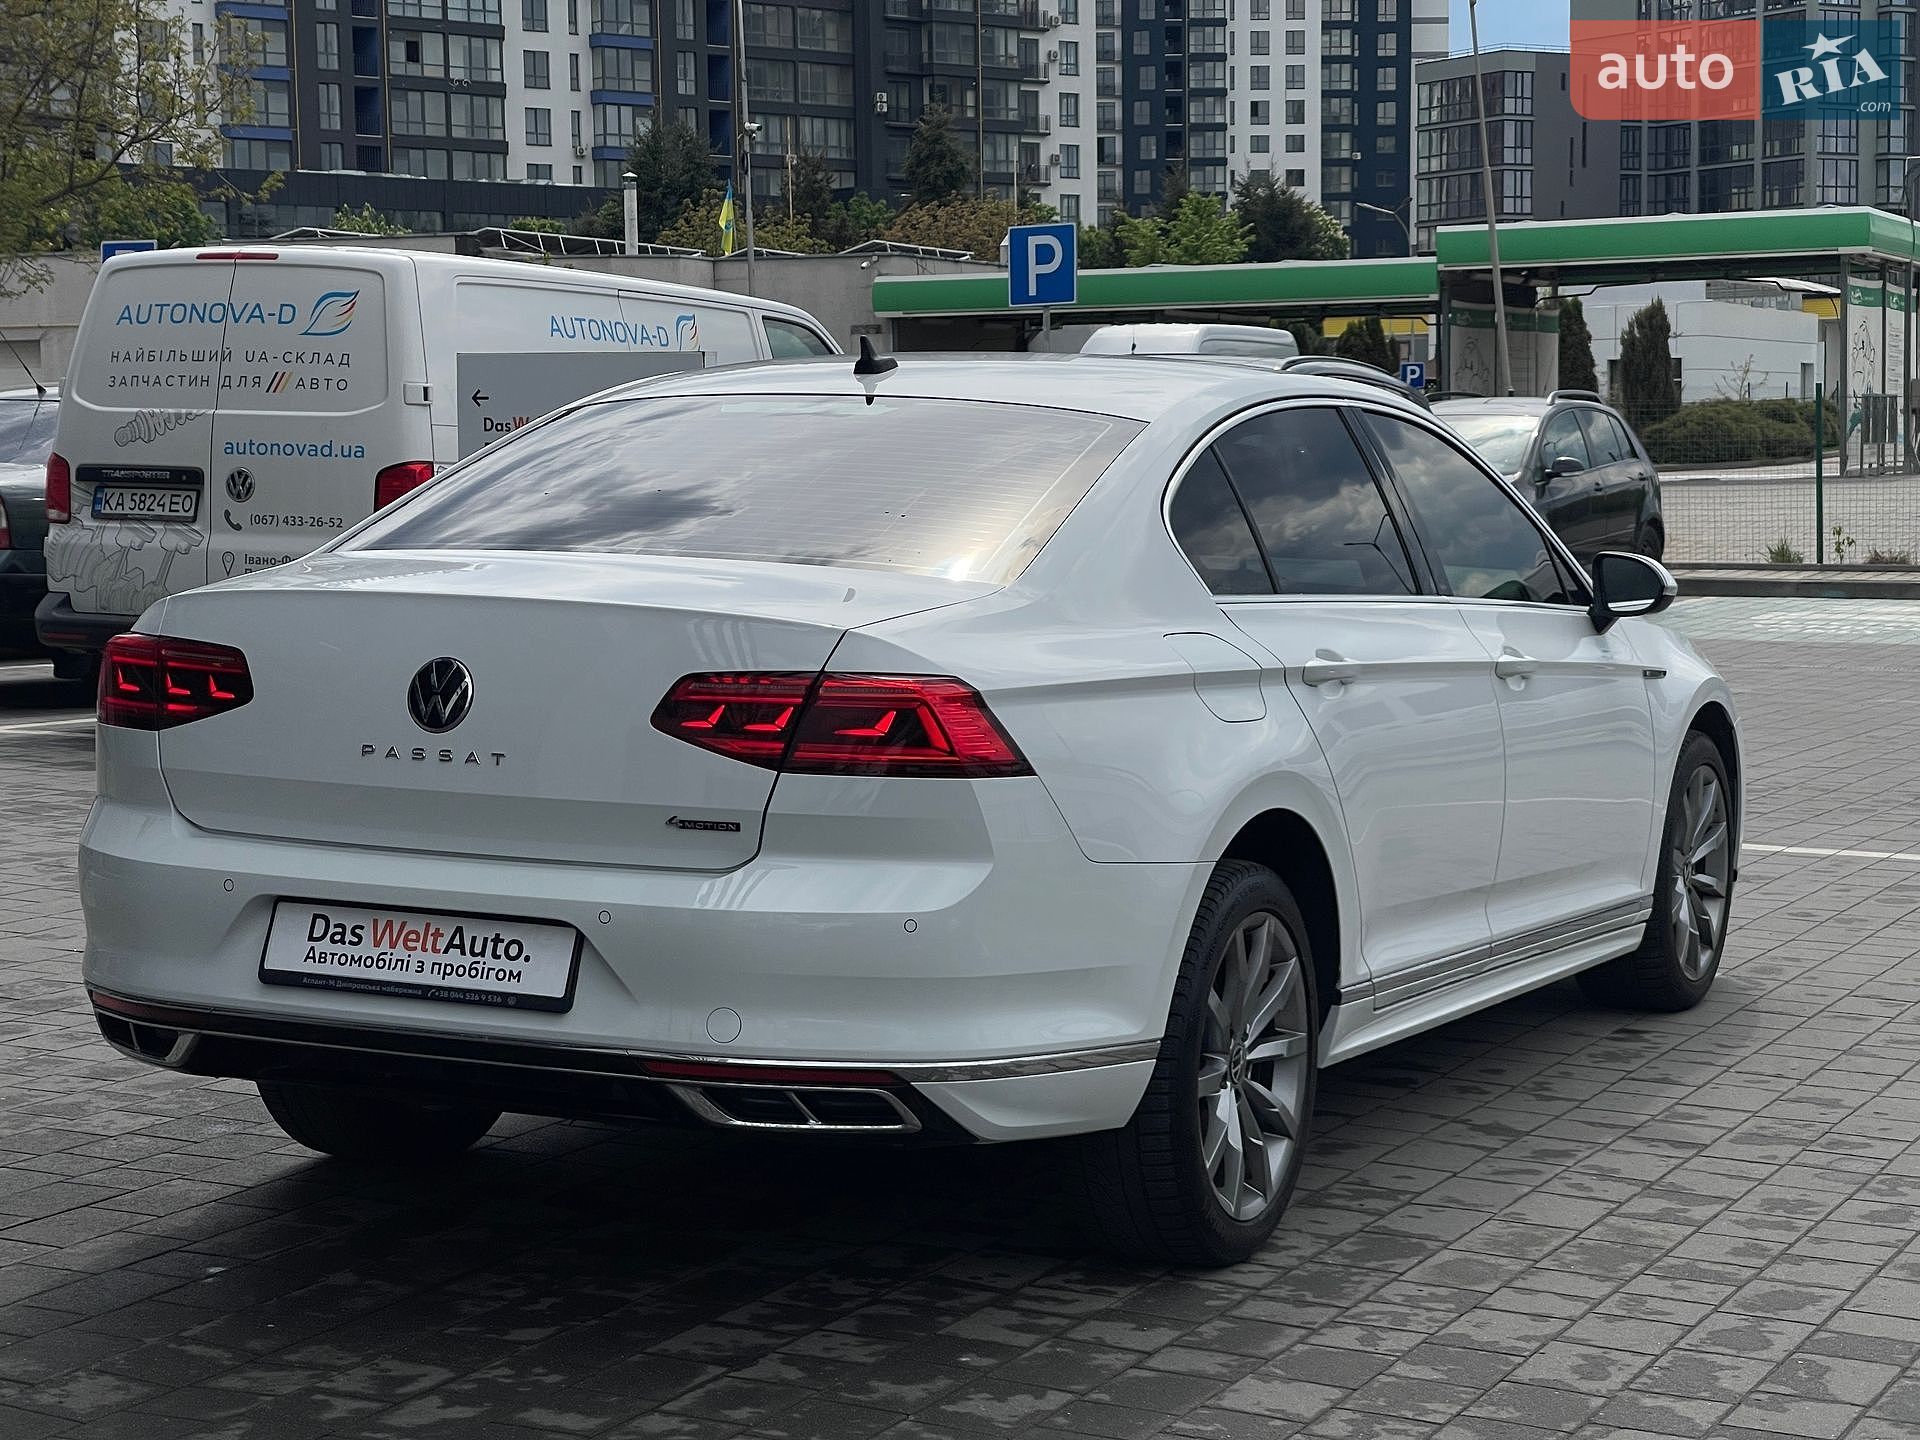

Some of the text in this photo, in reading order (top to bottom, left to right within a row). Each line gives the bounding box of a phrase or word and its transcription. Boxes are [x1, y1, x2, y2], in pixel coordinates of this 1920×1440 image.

[1028, 235, 1063, 296] P
[116, 302, 297, 326] AUTONOVA-D
[550, 315, 669, 347] AUTONOVA-D
[110, 346, 233, 364] НАЙБІЛЬШИЙ
[108, 374, 349, 391] ЗАПЧАСТИН ДЛЯ АВТО
[1407, 365, 1420, 385] P
[483, 417, 511, 432] Das
[223, 439, 365, 458] autonovad.ua
[128, 492, 166, 513] 5824
[250, 514, 343, 528] (067) 433-26-52
[360, 744, 507, 766] PASSAT
[307, 912, 365, 947] Das
[303, 945, 522, 984] Автомобілі з пробігом
